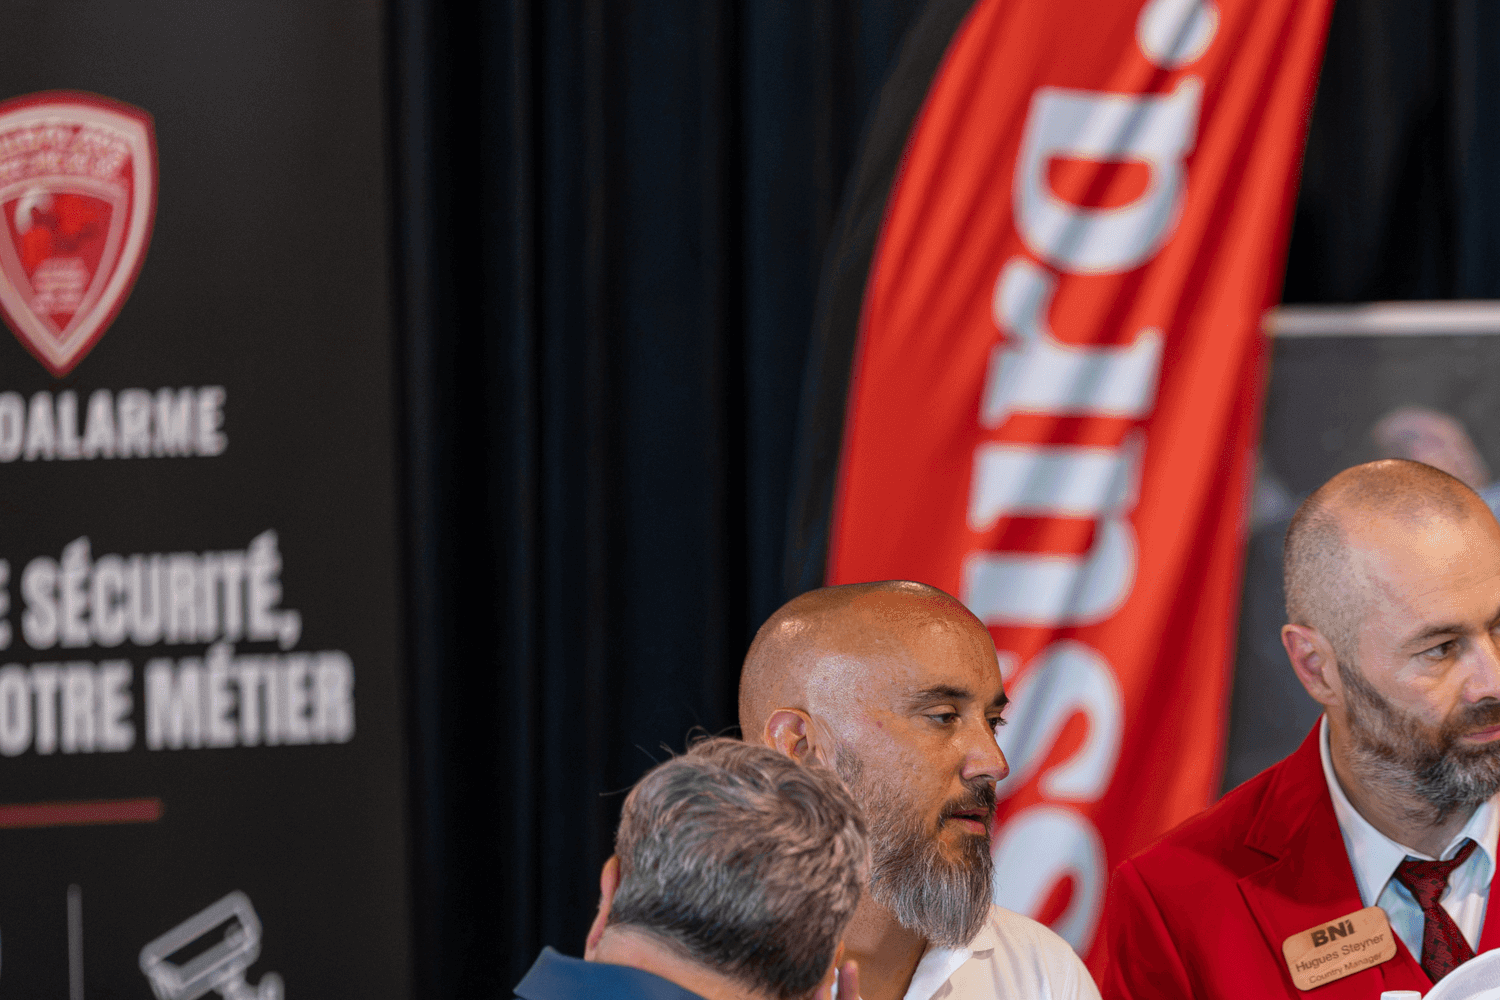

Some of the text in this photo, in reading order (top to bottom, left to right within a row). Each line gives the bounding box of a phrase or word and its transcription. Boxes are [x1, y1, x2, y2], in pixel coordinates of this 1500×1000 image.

[22, 531, 300, 650] SÉCURITÉ,
[144, 642, 355, 750] MÉTIER
[1295, 933, 1384, 972] Hugues Steyner
[1309, 952, 1382, 984] Country Manager
